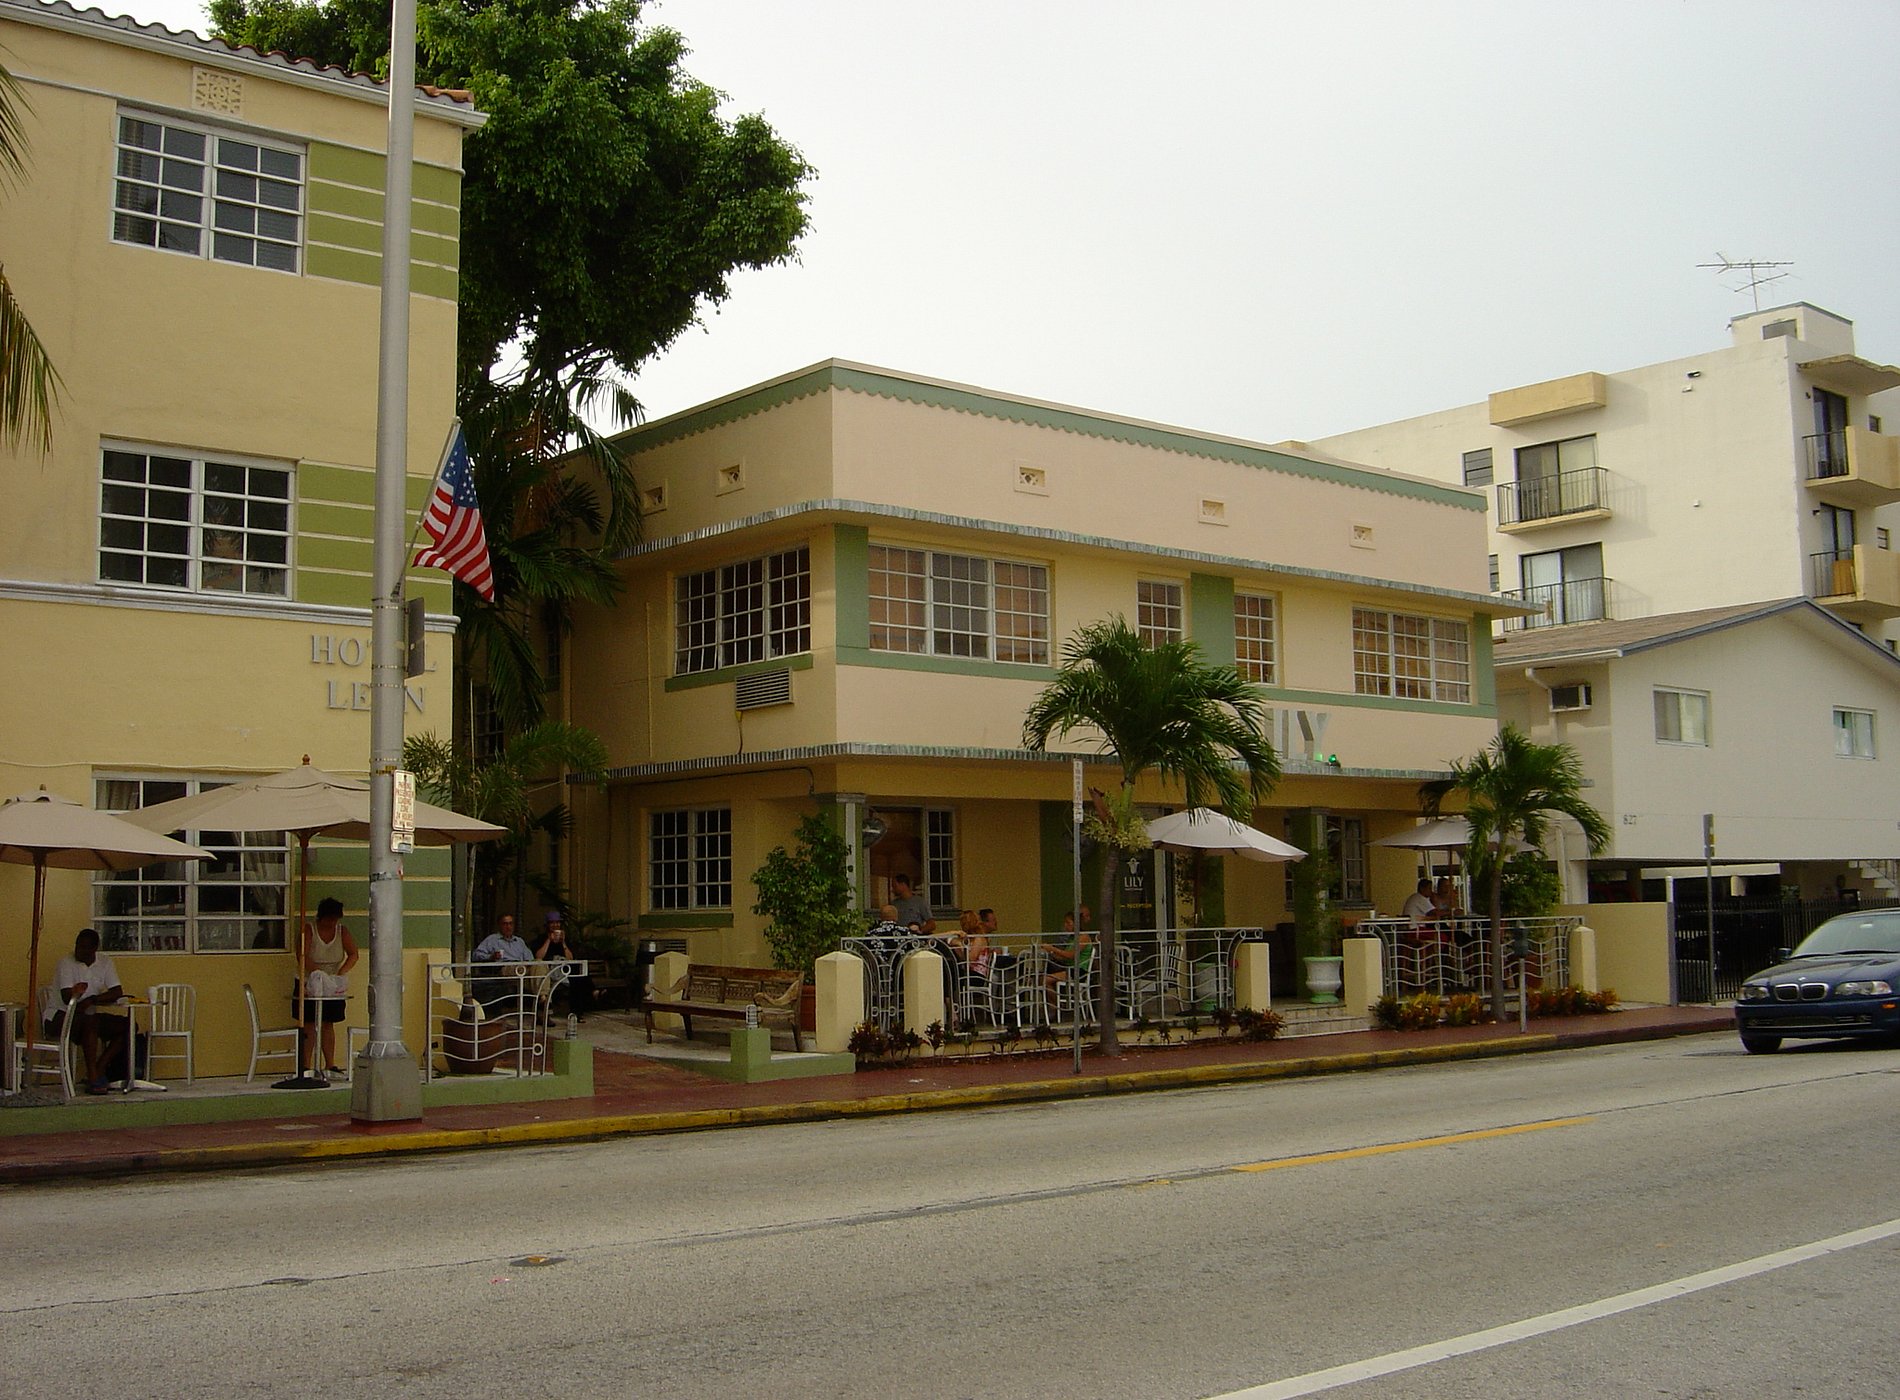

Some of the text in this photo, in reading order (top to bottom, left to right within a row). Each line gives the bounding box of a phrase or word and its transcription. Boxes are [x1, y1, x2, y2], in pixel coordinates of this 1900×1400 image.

[328, 680, 425, 713] LEN
[1263, 707, 1332, 762] ILY
[1623, 813, 1637, 825] 827
[1124, 876, 1144, 888] LILY
